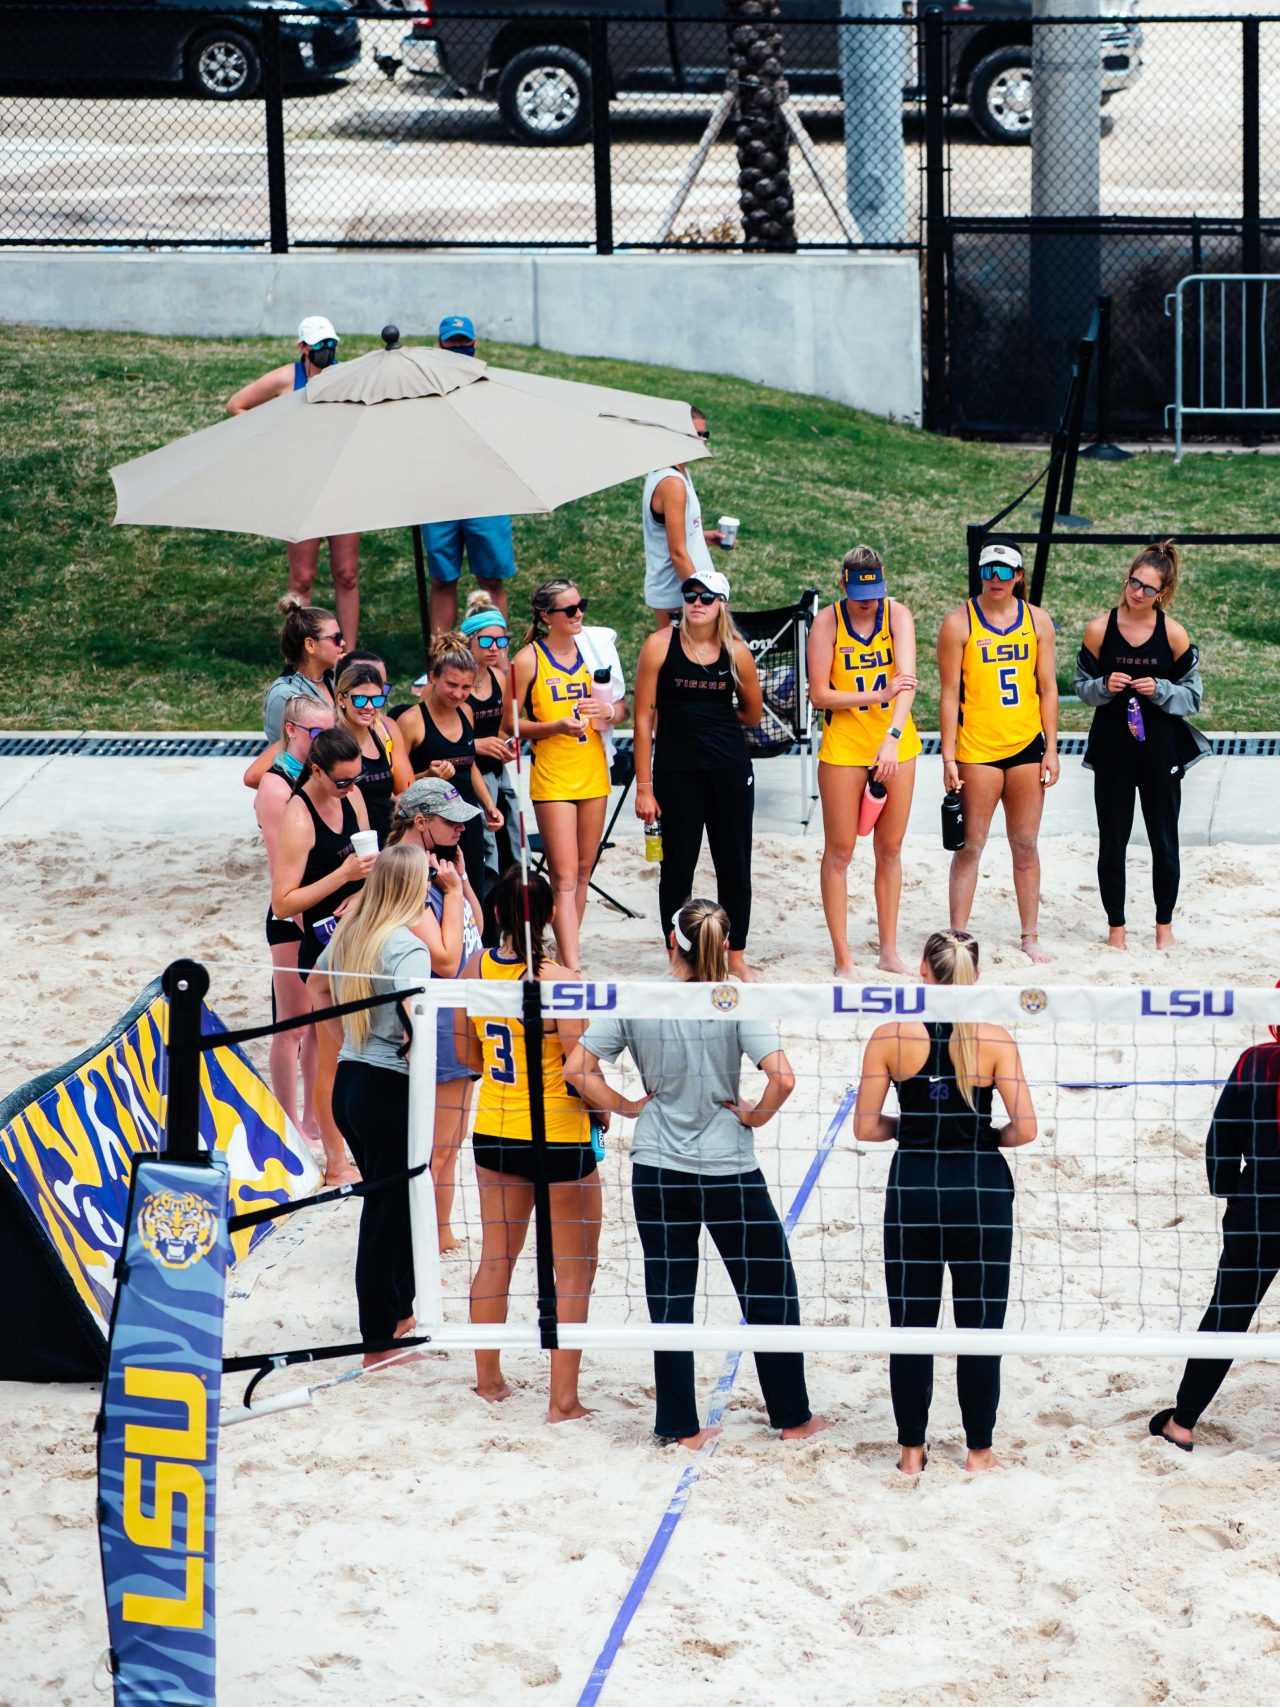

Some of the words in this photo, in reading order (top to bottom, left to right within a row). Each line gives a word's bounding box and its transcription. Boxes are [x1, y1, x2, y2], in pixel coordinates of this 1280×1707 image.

[859, 574, 876, 582] LSU
[844, 648, 893, 670] LSU
[982, 644, 1029, 663] LSU
[1115, 657, 1158, 665] TIGERS
[674, 678, 727, 689] TIGERS
[999, 667, 1020, 706] 5
[541, 983, 617, 1010] SU
[833, 986, 925, 1014] LSU
[1141, 989, 1234, 1016] LSU
[486, 1022, 515, 1084] 3
[929, 1083, 950, 1100] 23
[122, 1366, 207, 1630] LSU
